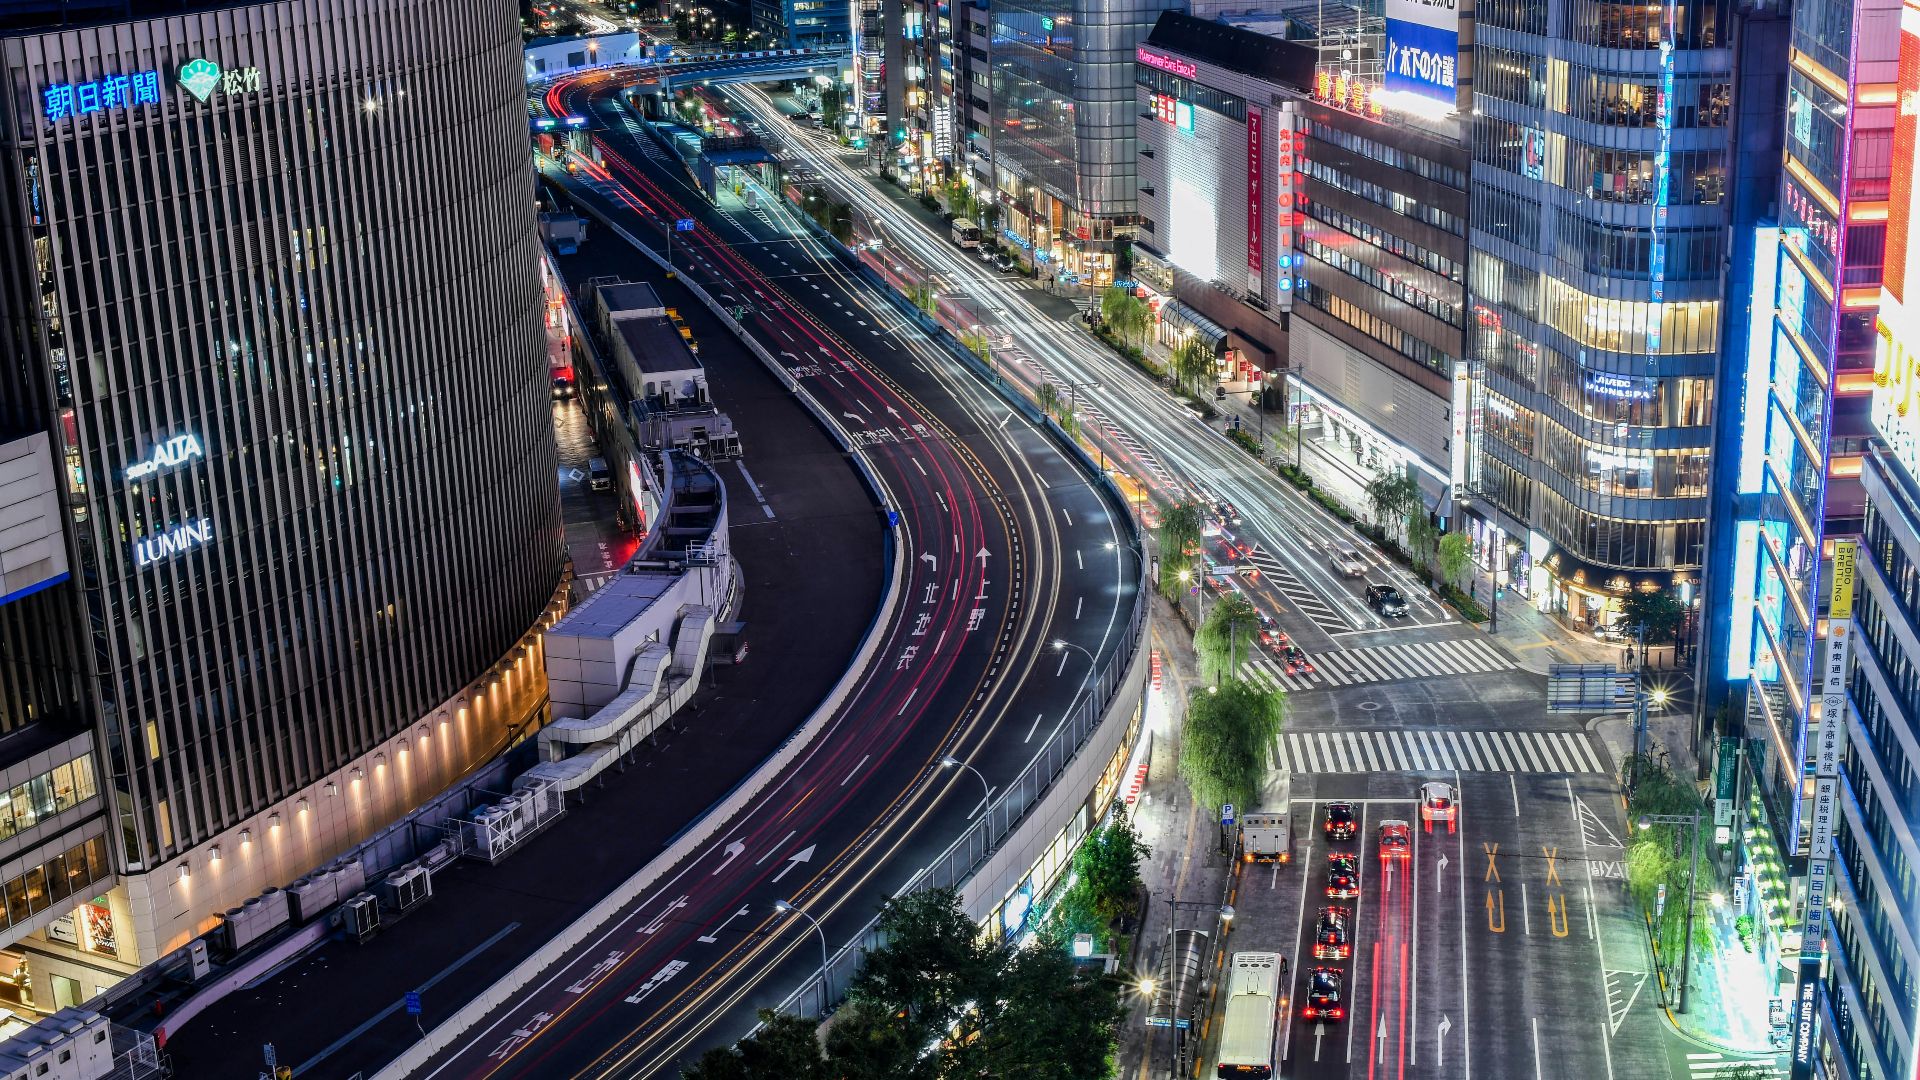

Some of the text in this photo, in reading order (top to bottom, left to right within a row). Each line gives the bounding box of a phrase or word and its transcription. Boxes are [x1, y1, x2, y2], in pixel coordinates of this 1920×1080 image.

[222, 66, 261, 97] 松竹
[1399, 45, 1455, 89] 木下の介護
[44, 69, 160, 122] 朝日新聞
[1279, 173, 1293, 248] TOEI
[899, 423, 932, 440] 上野
[136, 518, 213, 566] LUMINE
[1843, 547, 1854, 585] STUDIO
[1834, 547, 1846, 602] BREITLING
[896, 582, 940, 670] 北池袋
[966, 578, 991, 631] 上野
[1830, 640, 1843, 686] 新東通信
[1822, 708, 1838, 773] 塚本商事機械
[1224, 805, 1232, 814] P
[1815, 784, 1831, 855] 銀座税理士法人
[1807, 864, 1825, 936] 五百住歯科
[488, 895, 689, 1060] 北池袋
[624, 903, 750, 1004] 上野
[1797, 982, 1814, 1064] THE SUIT COMPANY
